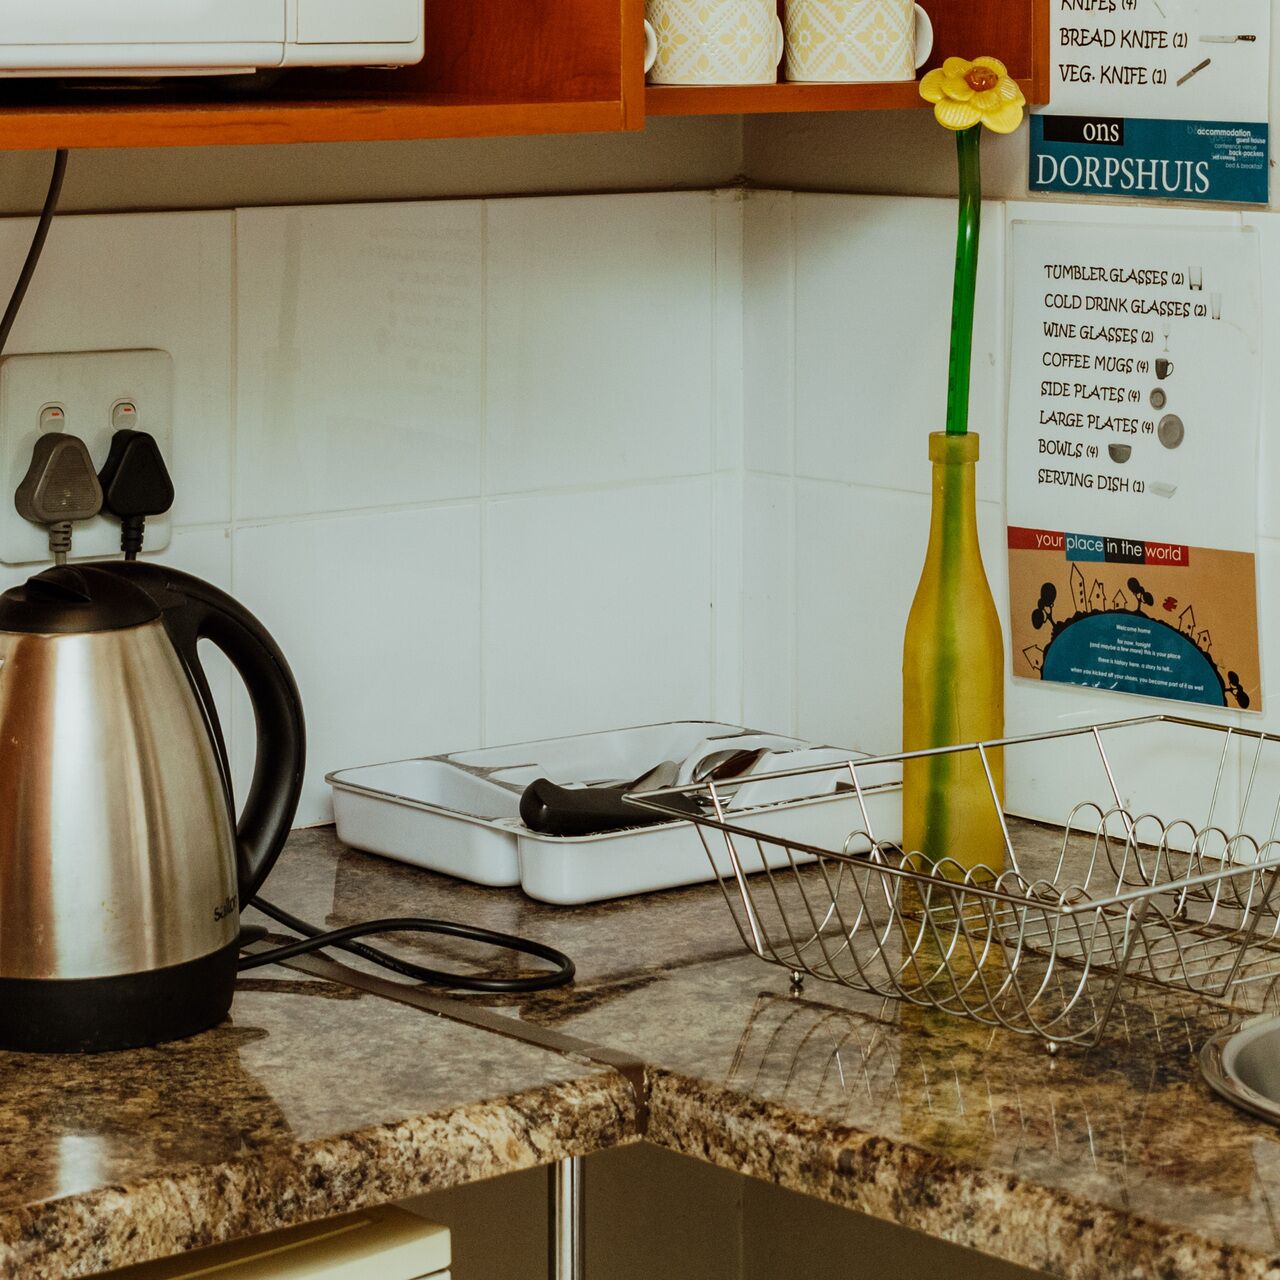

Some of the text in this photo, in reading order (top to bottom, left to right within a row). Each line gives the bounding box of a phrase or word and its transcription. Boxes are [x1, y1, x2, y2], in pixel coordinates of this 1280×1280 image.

[1059, 28, 1188, 49] BREAD KNIFE (1)
[1059, 64, 1167, 85] VEG. KNIFE (1)
[1083, 121, 1120, 142] ons
[1197, 128, 1252, 137] accommodation
[1036, 154, 1210, 194] DORPSHUIS
[1044, 264, 1184, 287] TUMBLER GLASSES (2)
[1044, 293, 1207, 318] COLD DRINK GLASSES (2)
[1043, 322, 1154, 344] WINE GLASSES (2)
[1042, 352, 1149, 373] COFFEE MUGS (4)
[1040, 381, 1141, 403] SIDE PLATES (4)
[1039, 410, 1154, 434] LARGE PLATES (4)
[1038, 438, 1099, 458] BOWLS (4)
[1038, 469, 1145, 493] SERVING DISH (1)
[1035, 532, 1182, 562] your place in the world
[1116, 624, 1137, 632] Welcome
[1148, 678, 1168, 686] become
